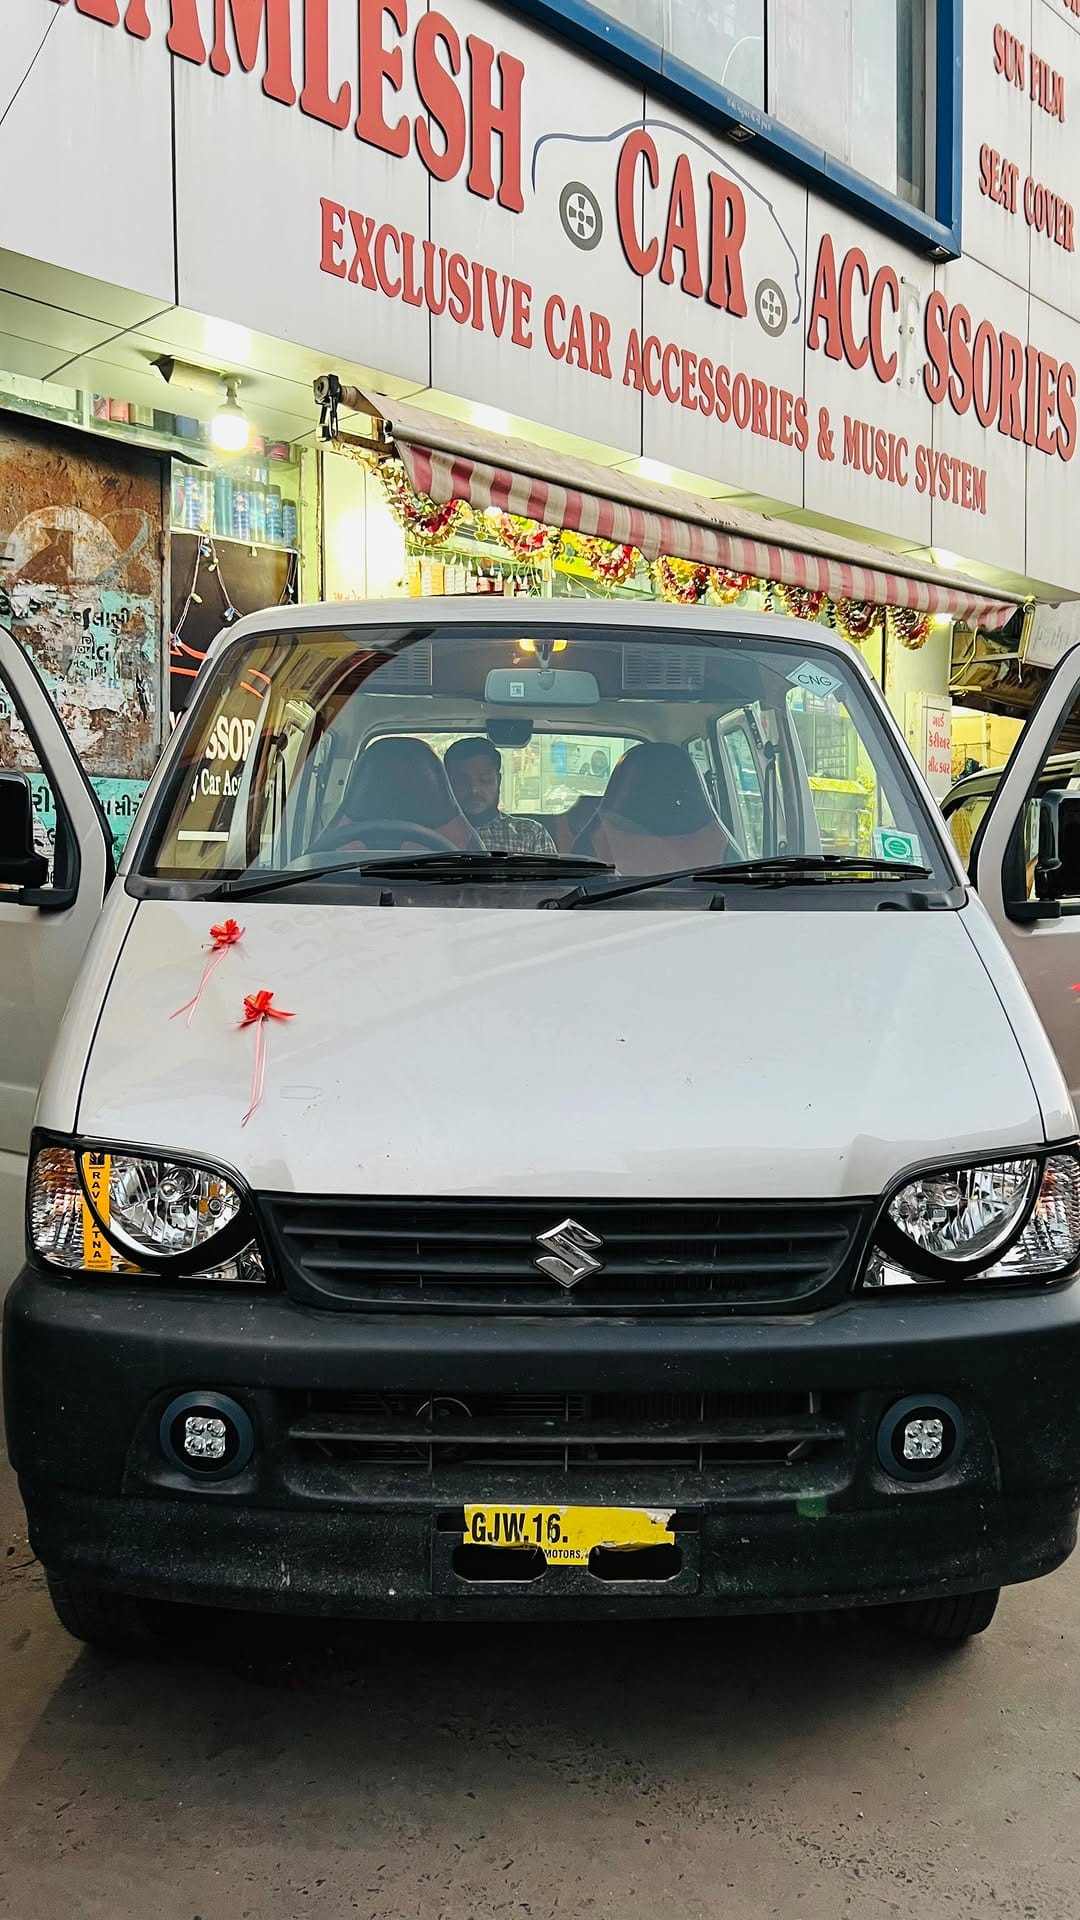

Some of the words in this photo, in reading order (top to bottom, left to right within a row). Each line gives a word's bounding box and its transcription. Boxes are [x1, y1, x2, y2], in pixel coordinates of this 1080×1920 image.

[993, 23, 1024, 91] SUN
[1030, 52, 1065, 123] FILM
[979, 143, 1019, 214] SEAT
[1023, 176, 1075, 253] COVER
[617, 129, 748, 319] CAR
[808, 234, 1077, 462] ACCSSORIES
[319, 197, 533, 349] EXCLUSIVE
[544, 294, 612, 379] CAR
[623, 328, 809, 453] ACCESSORIES
[817, 407, 835, 462] &
[843, 415, 909, 487] MUSIC
[915, 444, 988, 515] SYSTEM
[797, 674, 832, 688] CNG
[201, 768, 221, 796] Car
